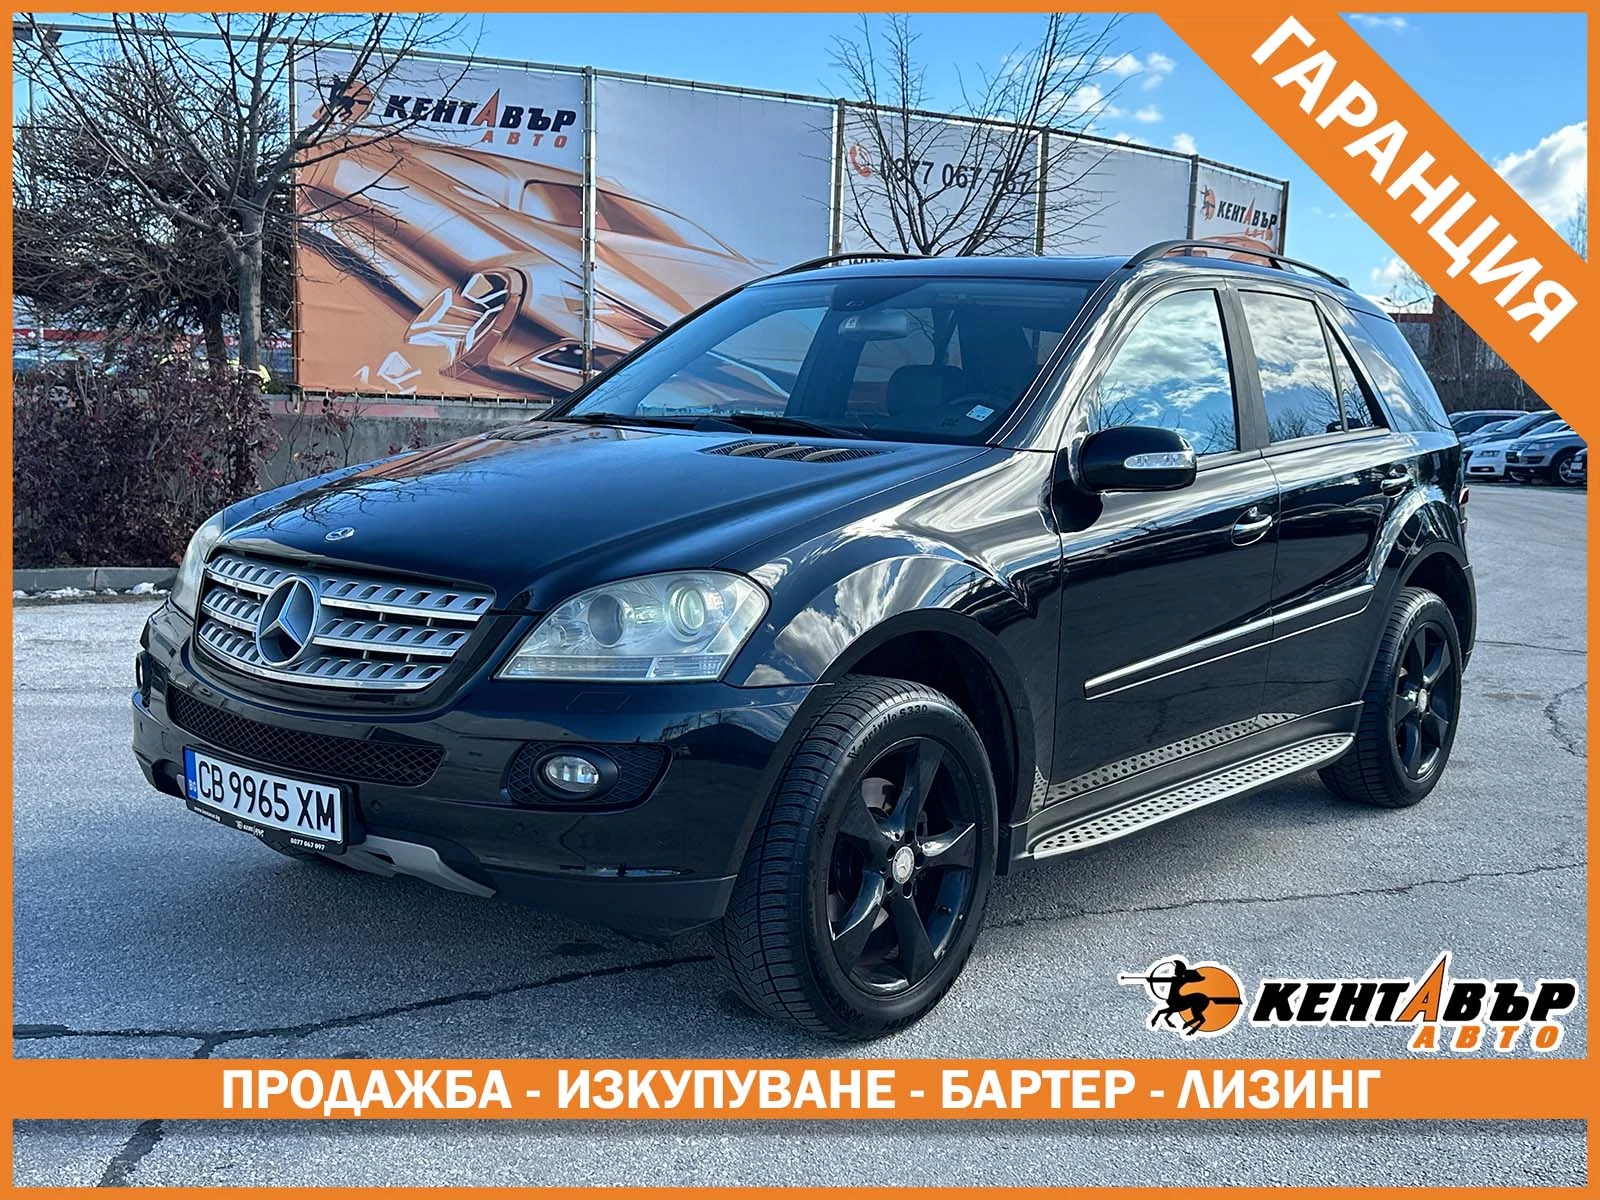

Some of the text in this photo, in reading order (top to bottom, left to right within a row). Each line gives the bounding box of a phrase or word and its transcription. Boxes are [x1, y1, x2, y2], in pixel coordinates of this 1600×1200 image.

[384, 88, 577, 133] КЕНТАВЪР
[480, 129, 568, 148] АВТО
[942, 163, 982, 190] 067
[1217, 196, 1278, 230] КЕНТАВЪР
[899, 704, 928, 718] S330
[229, 771, 290, 822] 9965
